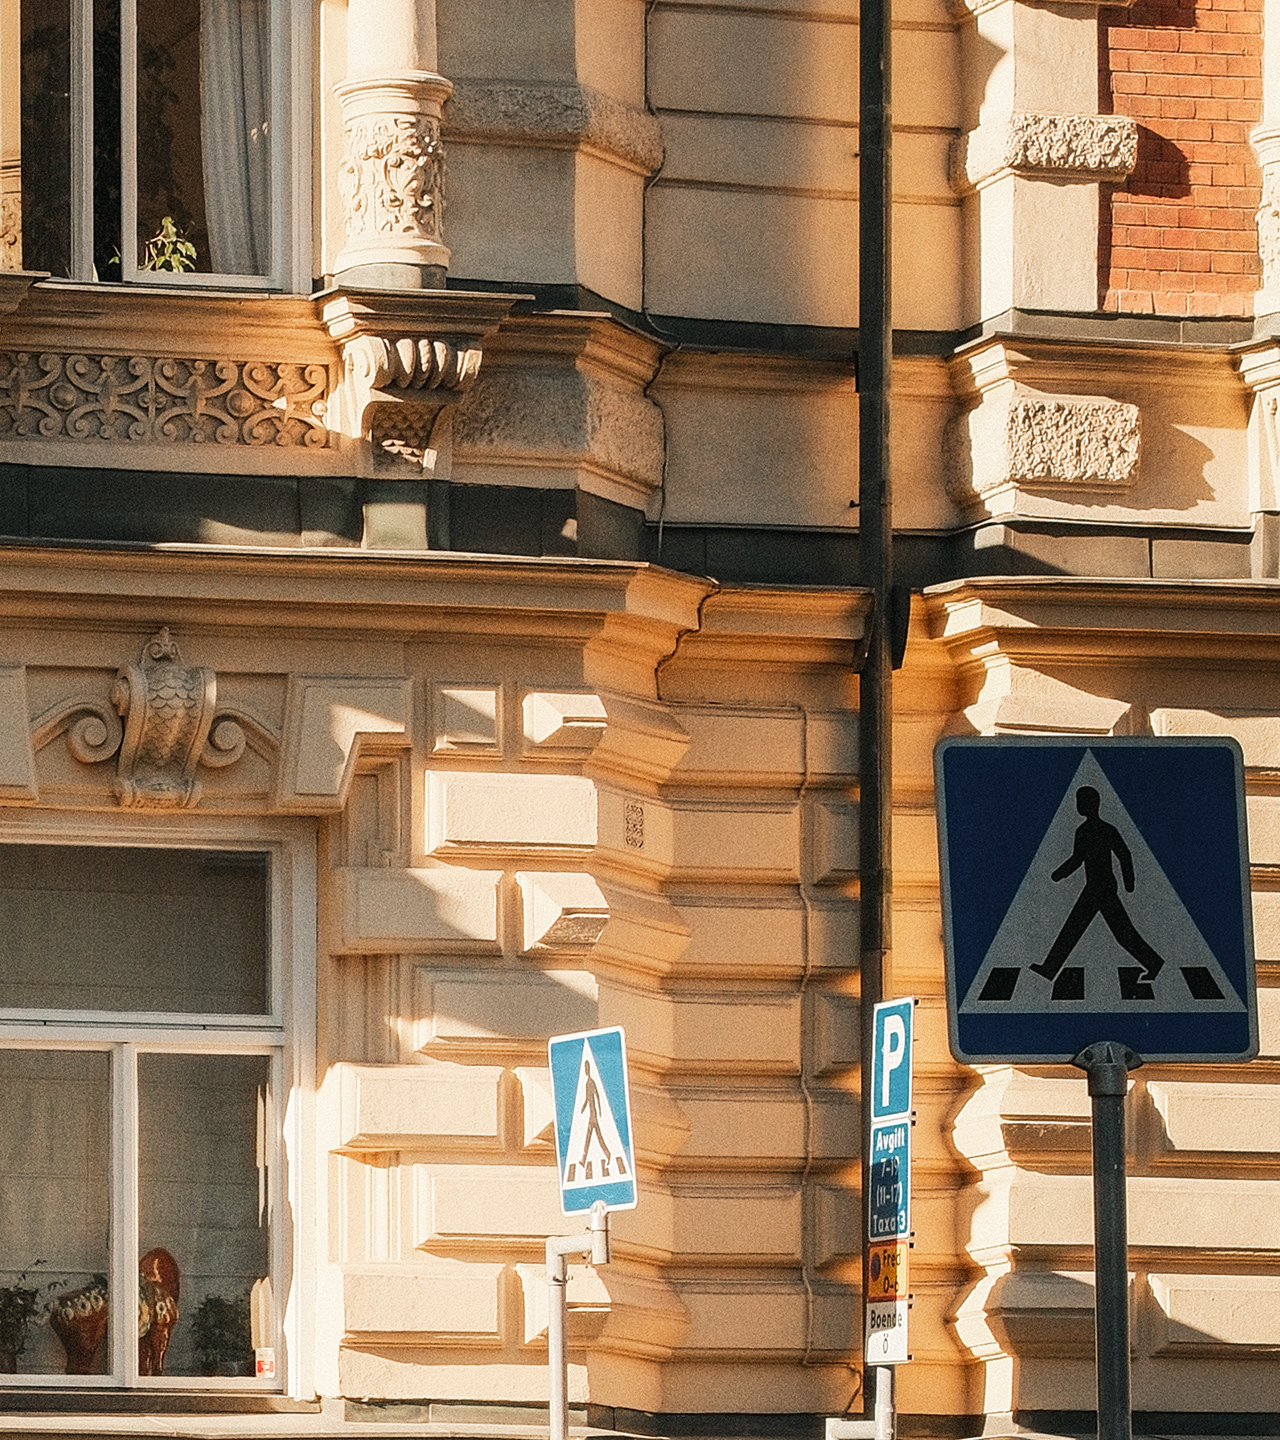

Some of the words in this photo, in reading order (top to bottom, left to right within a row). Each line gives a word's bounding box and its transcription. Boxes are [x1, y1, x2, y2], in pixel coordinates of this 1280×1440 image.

[881, 1013, 906, 1108] P
[875, 1127, 905, 1154] Avgift
[872, 1213, 896, 1234] Taxa
[897, 1209, 906, 1231] 3
[870, 1309, 903, 1329] Boende
